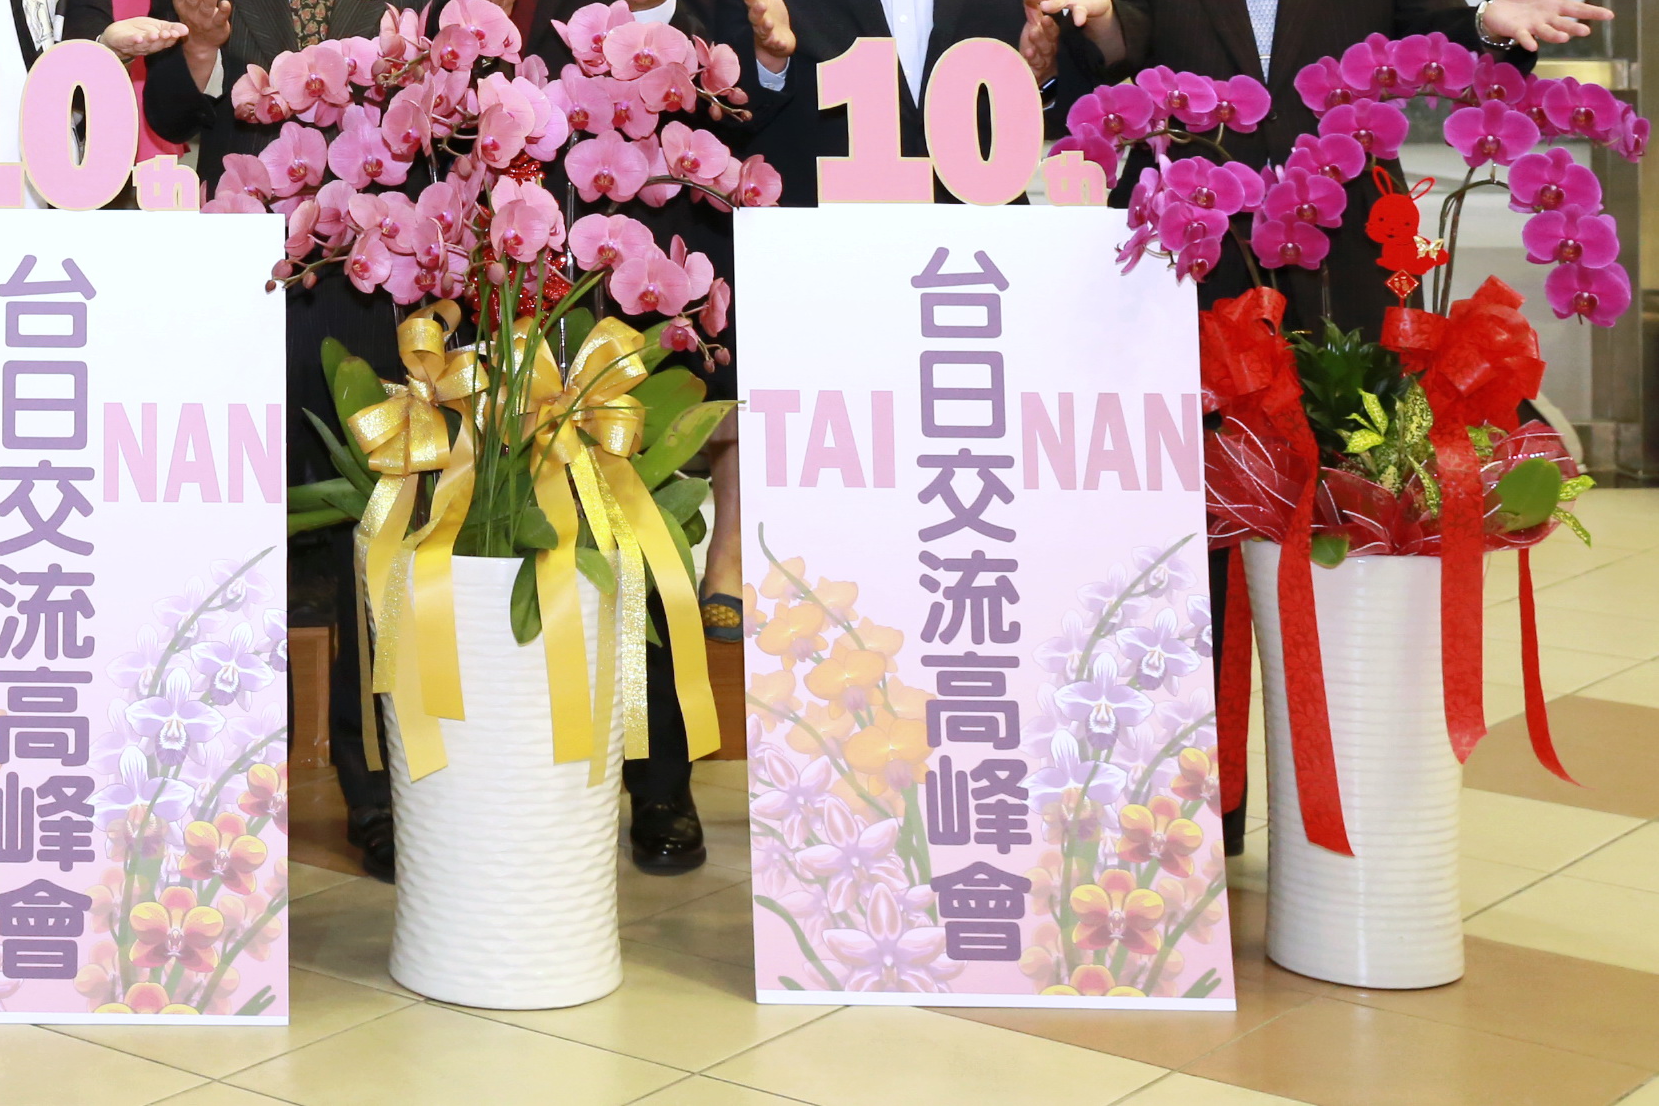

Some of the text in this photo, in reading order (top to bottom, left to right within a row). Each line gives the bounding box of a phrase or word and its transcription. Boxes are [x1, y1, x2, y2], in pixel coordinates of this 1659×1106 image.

[103, 401, 283, 504] NAN
[748, 389, 1201, 492] TAI NAN
[910, 246, 1032, 961] 台日交流高峰會
